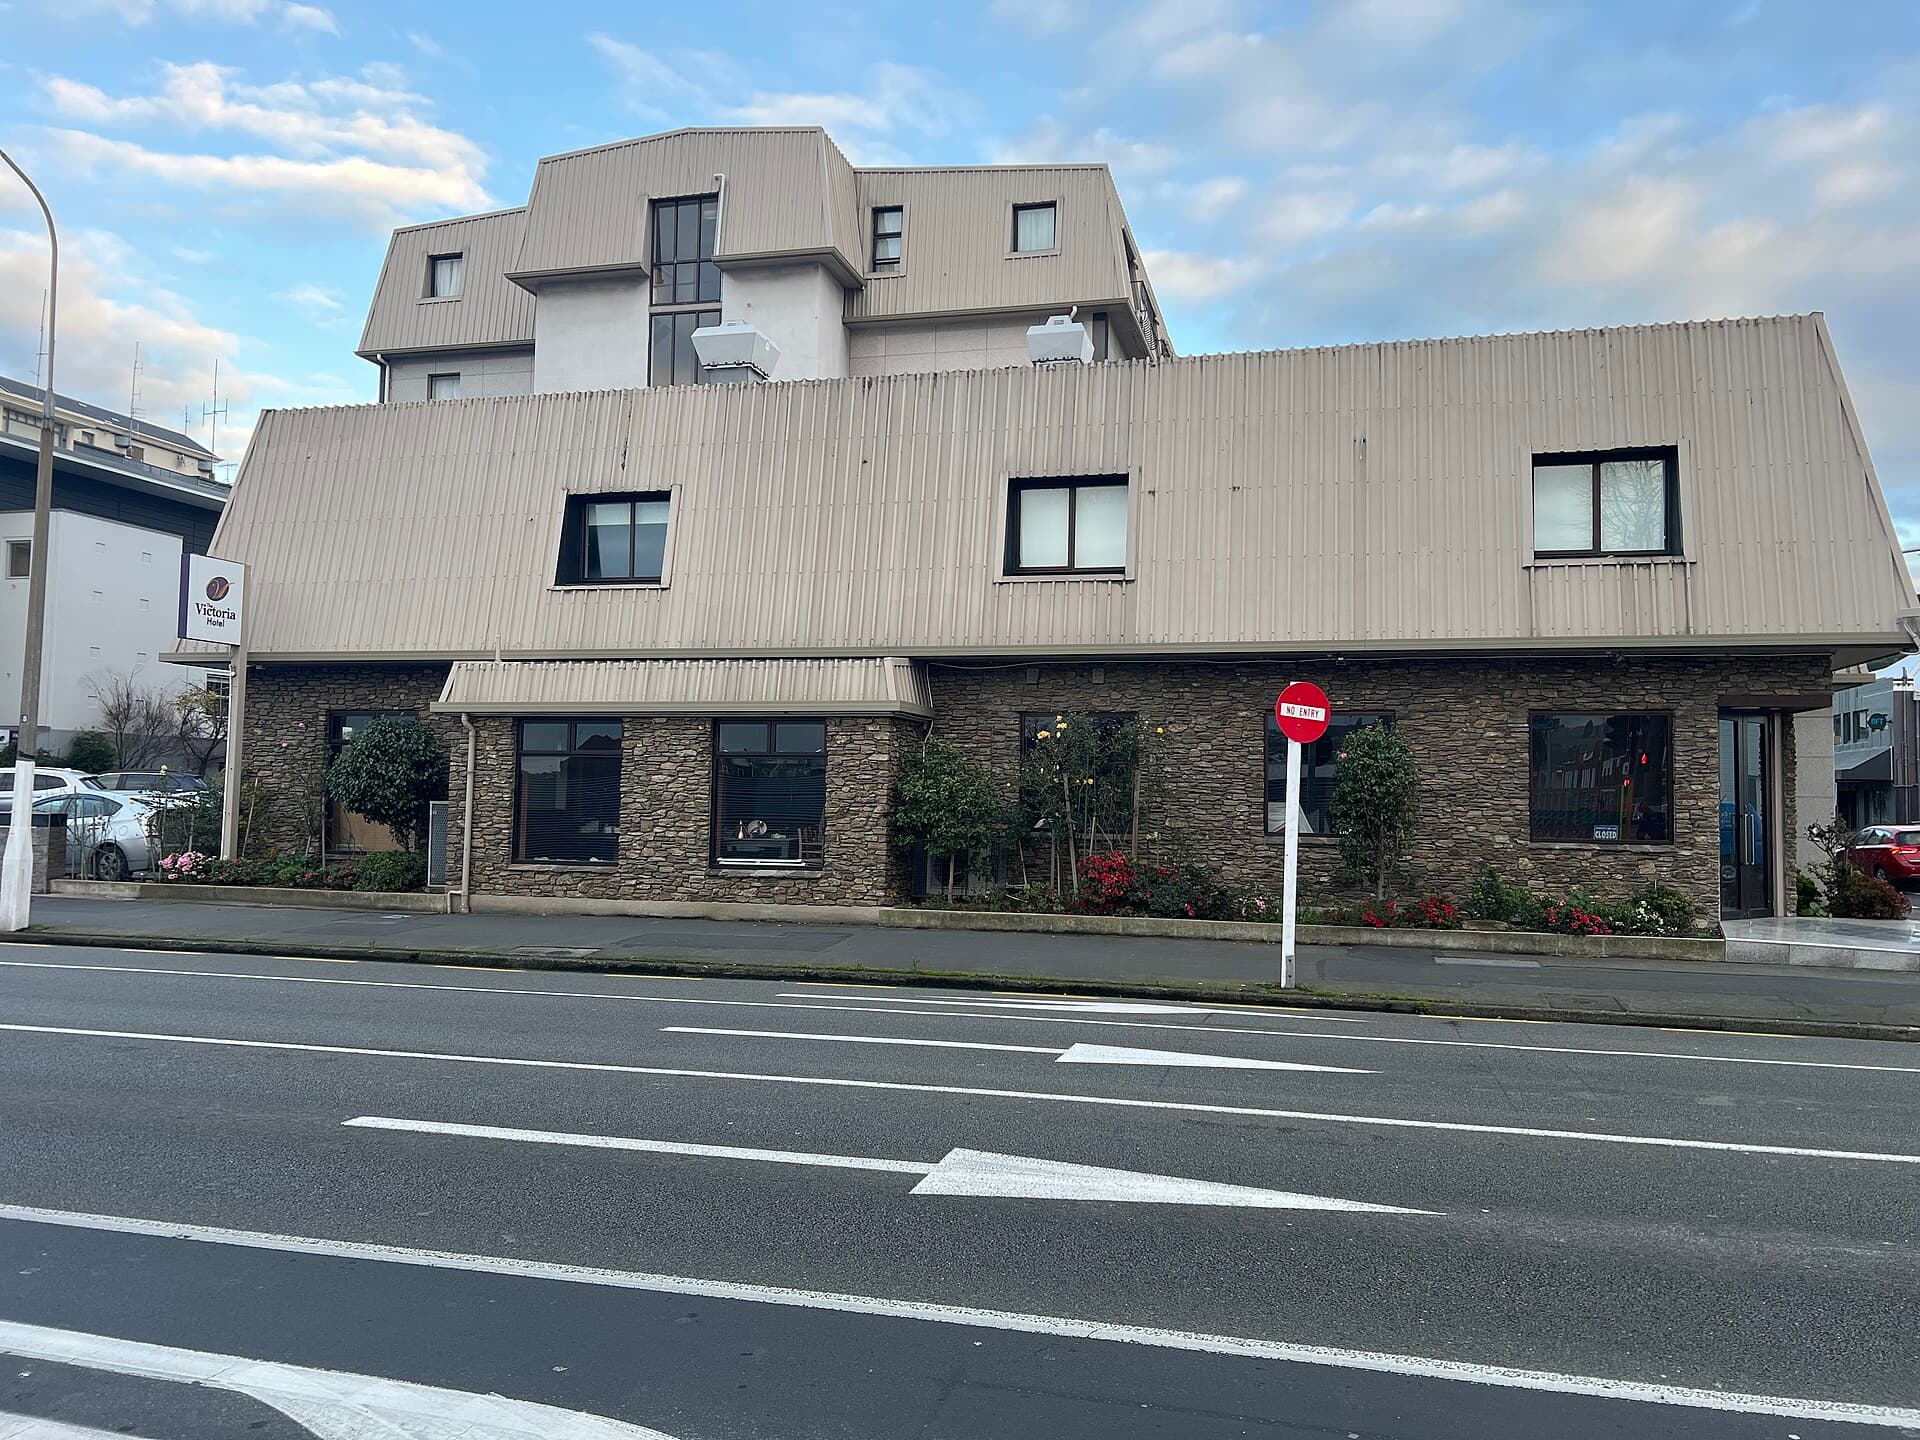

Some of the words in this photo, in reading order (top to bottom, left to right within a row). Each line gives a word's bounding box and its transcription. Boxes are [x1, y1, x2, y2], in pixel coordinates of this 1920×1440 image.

[195, 603, 236, 620] Victoria
[207, 618, 225, 627] Hotel
[1286, 705, 1295, 715] NO
[1299, 707, 1319, 719] ENTRY
[1595, 830, 1617, 839] CLOSED
